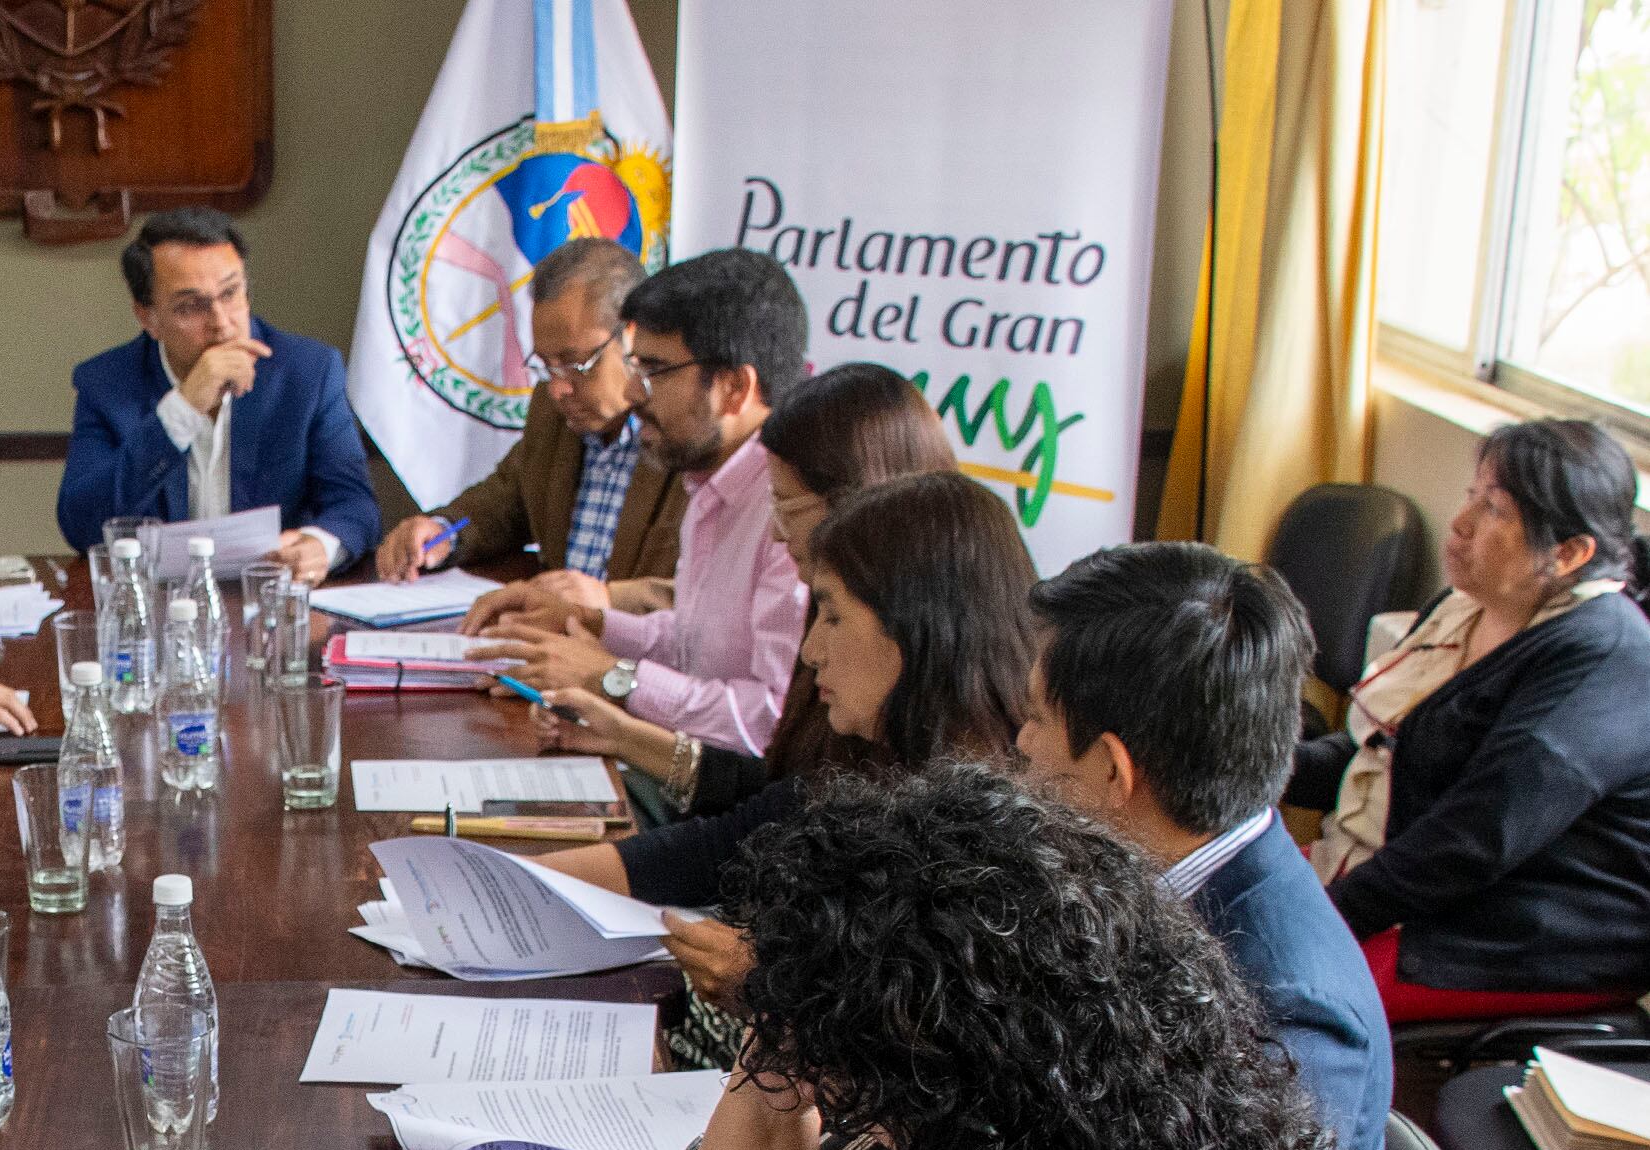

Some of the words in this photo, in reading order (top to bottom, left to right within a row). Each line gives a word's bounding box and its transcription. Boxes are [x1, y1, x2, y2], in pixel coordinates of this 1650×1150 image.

[736, 177, 1105, 285] Parlamento
[828, 281, 920, 344] del
[943, 298, 1084, 355] Gran
